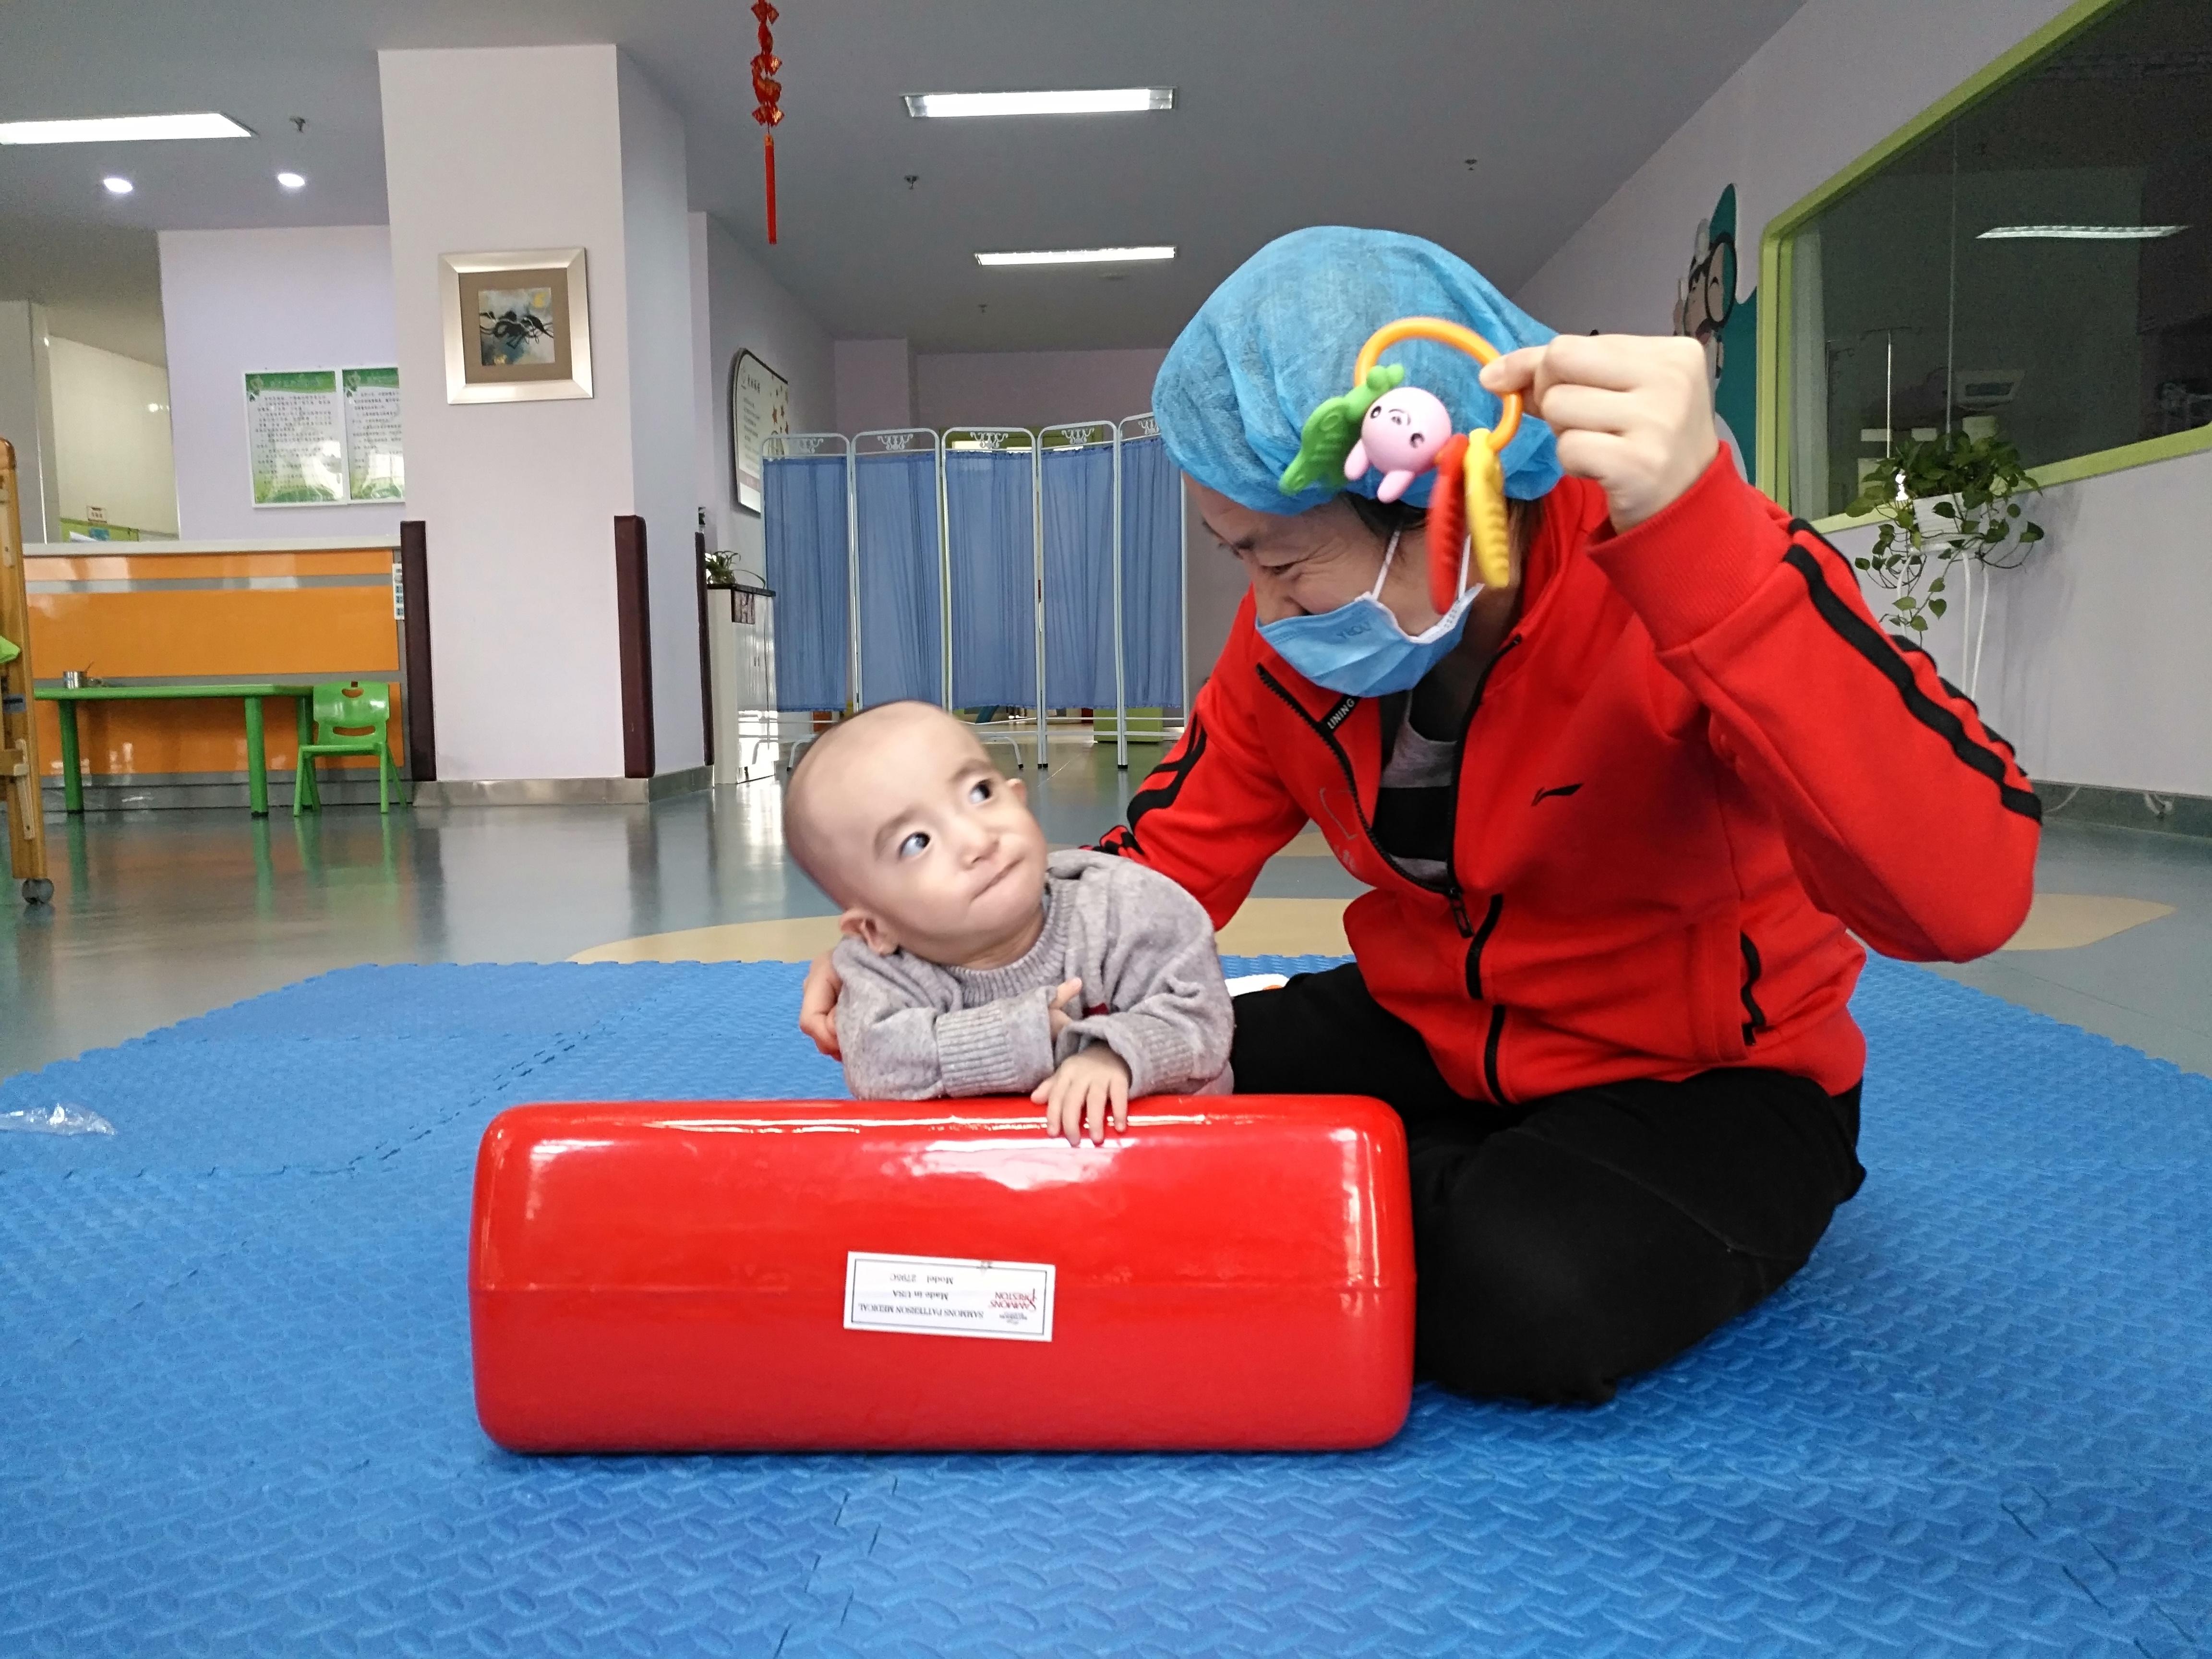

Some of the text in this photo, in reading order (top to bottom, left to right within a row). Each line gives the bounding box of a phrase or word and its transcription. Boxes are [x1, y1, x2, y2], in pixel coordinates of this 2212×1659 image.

[1327, 698, 1355, 729] LINING
[927, 1275, 953, 1285] Model
[892, 1290, 911, 1298] USA
[925, 1290, 948, 1300] Made
[859, 1303, 984, 1318] SAMMONS PATTERSON MEDICAL
